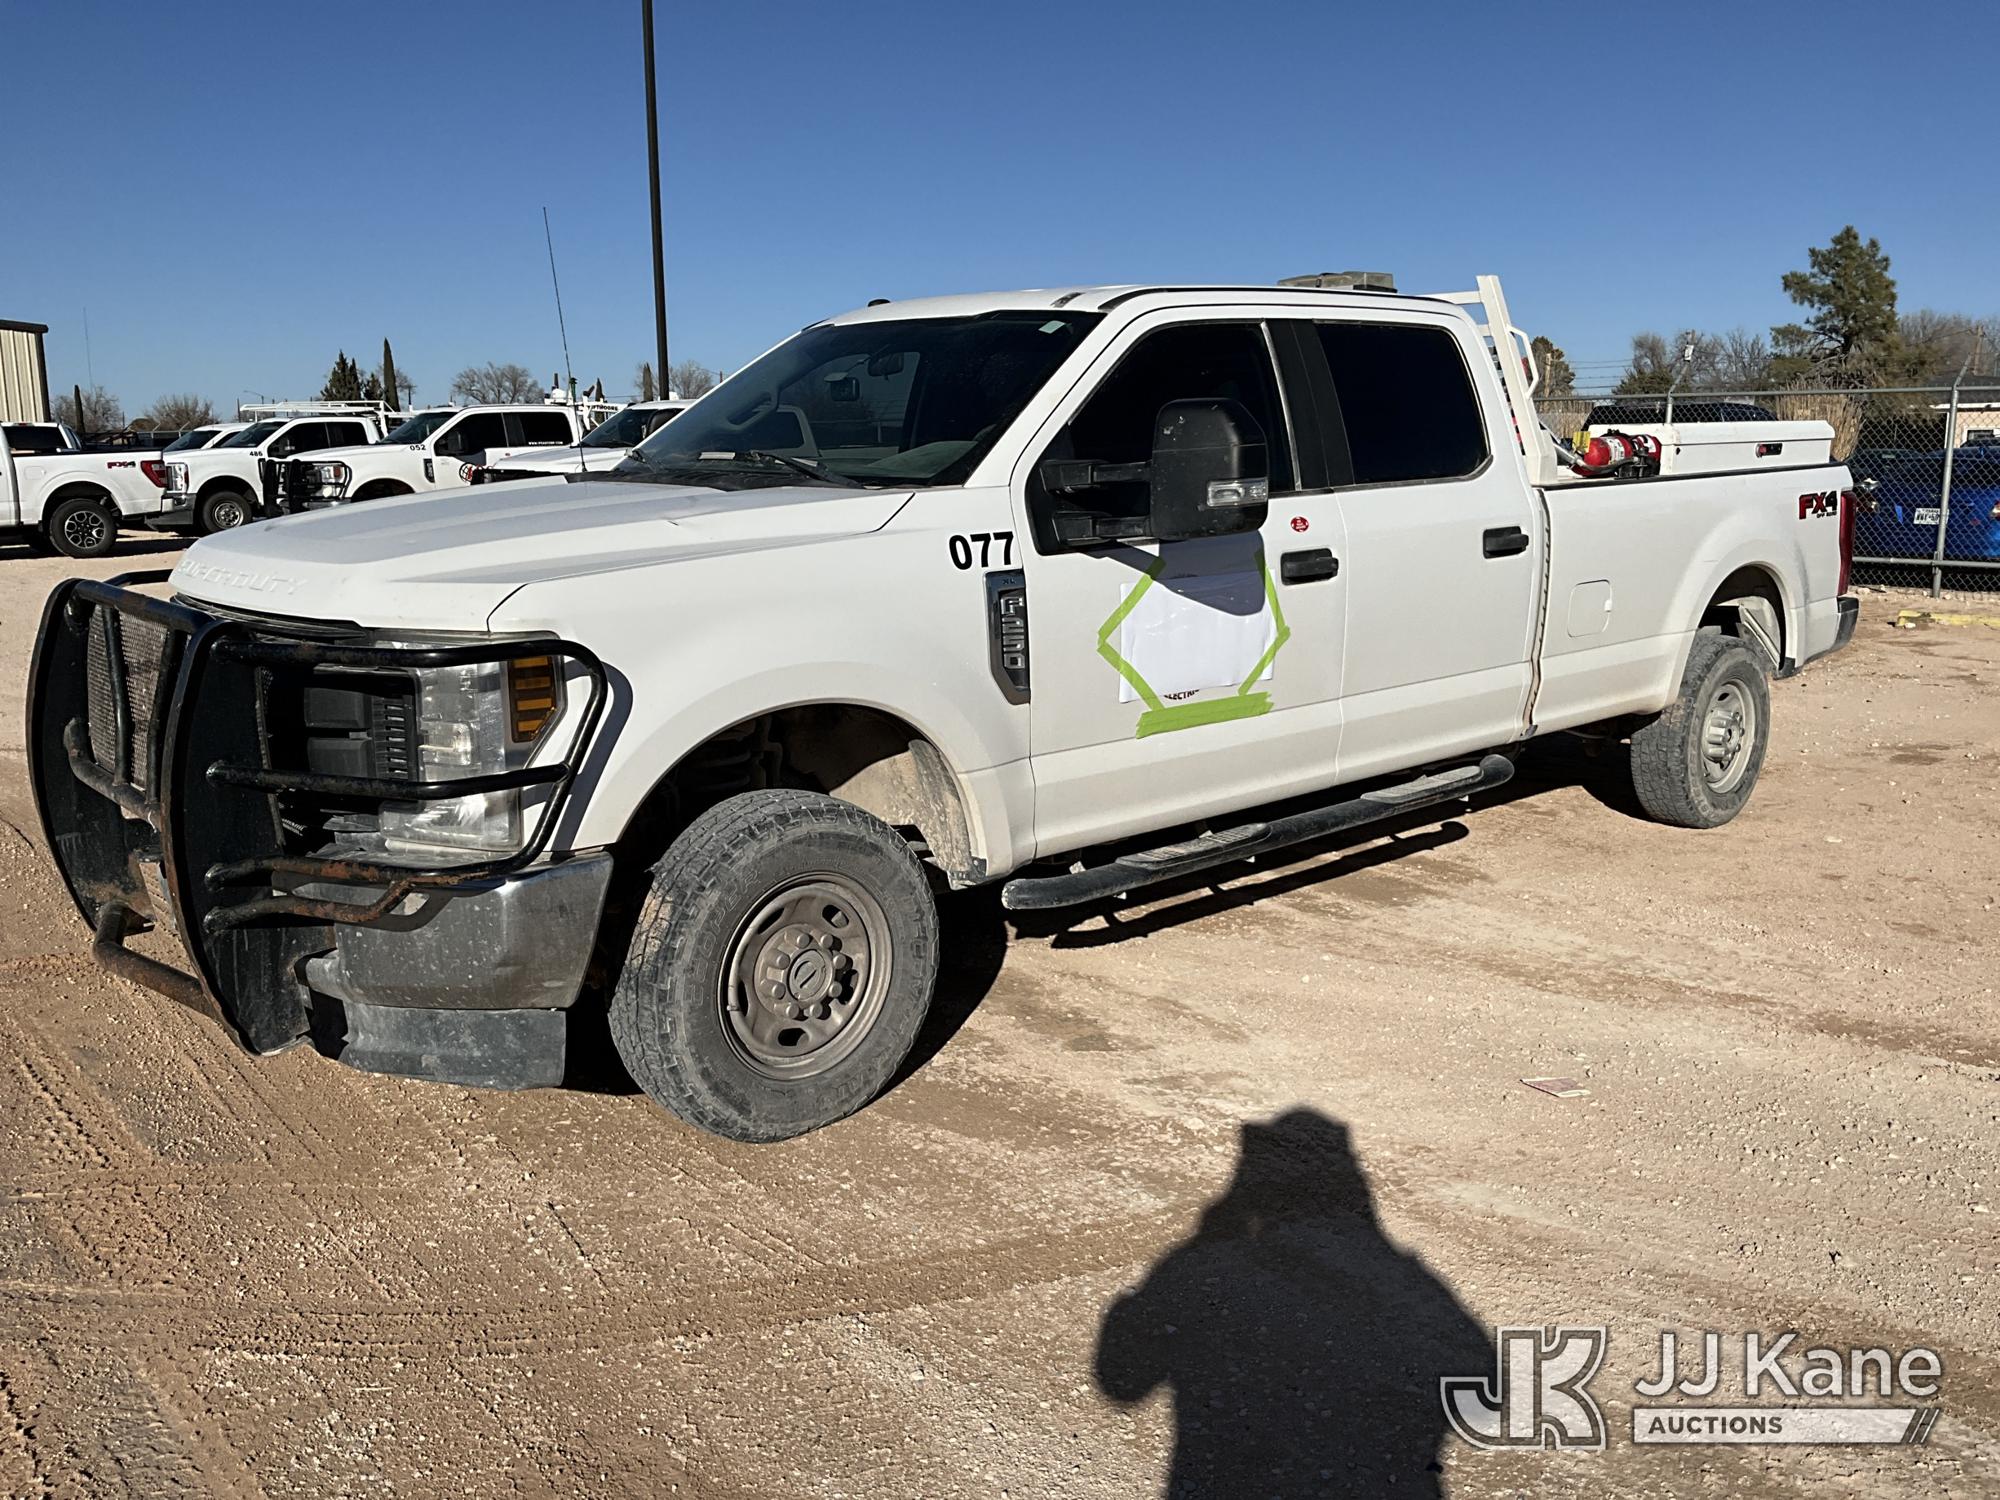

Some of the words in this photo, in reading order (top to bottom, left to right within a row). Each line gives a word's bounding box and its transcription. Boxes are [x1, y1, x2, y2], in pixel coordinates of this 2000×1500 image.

[107, 461, 136, 469] FX4
[1799, 490, 1838, 520] FX4
[949, 531, 1014, 570] 077
[231, 570, 308, 595] DUTY
